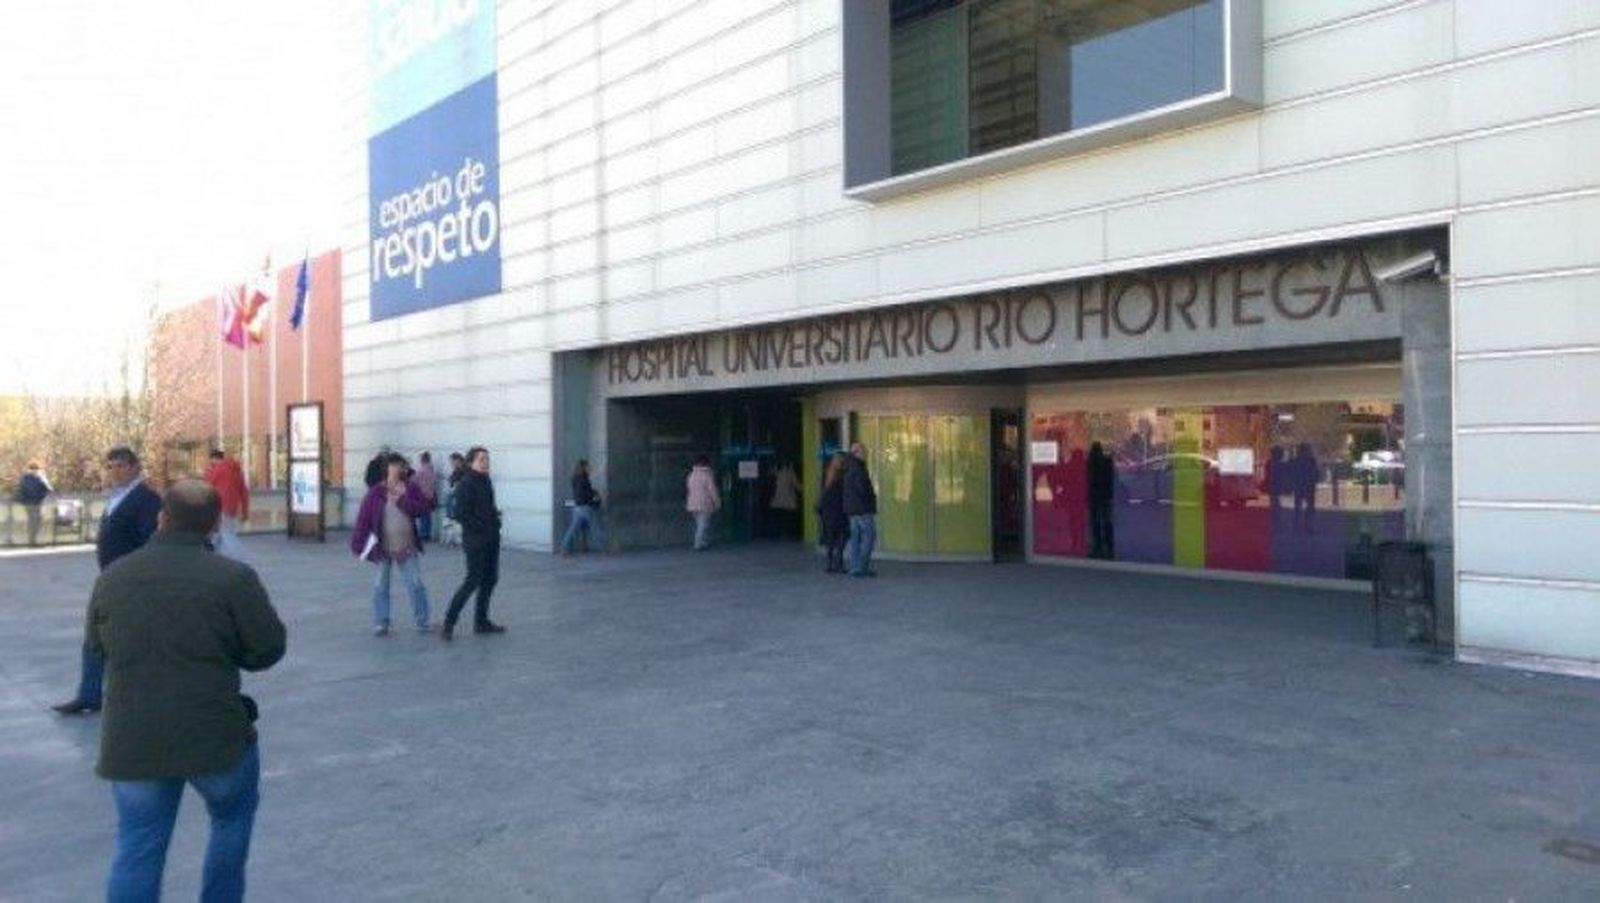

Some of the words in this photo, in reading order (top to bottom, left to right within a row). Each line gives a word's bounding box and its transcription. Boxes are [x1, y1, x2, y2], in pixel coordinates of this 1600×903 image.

[379, 170, 451, 231] espacio
[455, 156, 486, 197] de
[372, 199, 498, 289] respeto
[608, 337, 713, 384] HOSPITAL
[723, 307, 959, 374] UNIVERSITARIO
[1076, 248, 1384, 341] HORTEGA
